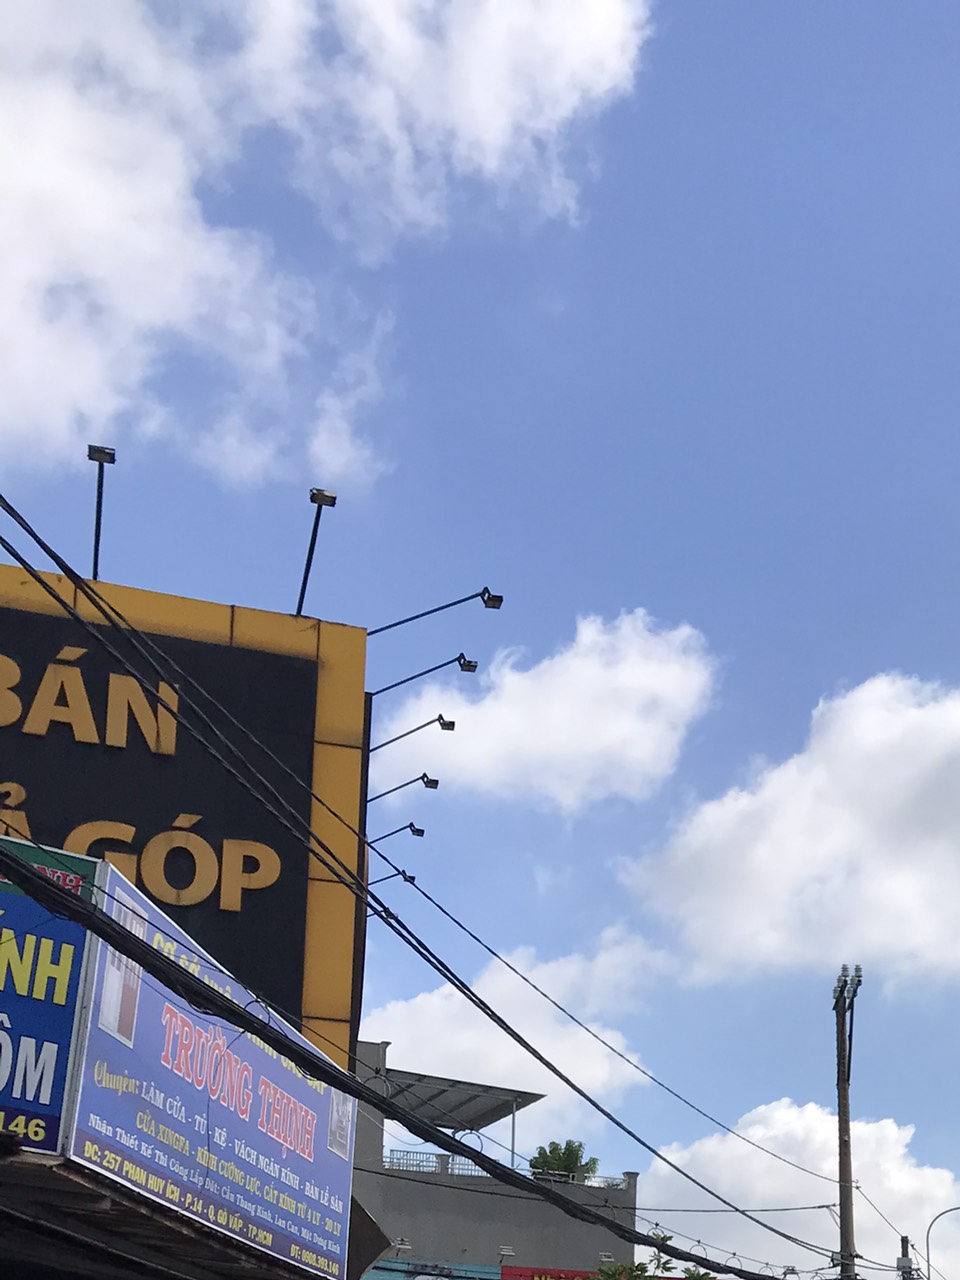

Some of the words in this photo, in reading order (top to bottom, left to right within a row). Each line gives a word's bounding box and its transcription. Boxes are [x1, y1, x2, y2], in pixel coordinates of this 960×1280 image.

[63, 813, 281, 912] GÓP
[0, 910, 75, 1006] NH
[161, 1003, 253, 1122] TRƯỜNG
[258, 1075, 317, 1162] THỊNH
[88, 1113, 113, 1137] Nhận
[115, 1127, 139, 1151] Thiết
[140, 1141, 154, 1159] Kế
[154, 1150, 168, 1167] Thi
[169, 1158, 189, 1181] Công
[136, 1109, 156, 1137] CỬA
[278, 1191, 296, 1214] KÍNH
[141, 1081, 165, 1109] LÀM
[166, 1096, 186, 1123] CỬA
[213, 1127, 227, 1150] KỆ
[234, 1139, 257, 1165] VÁCH
[281, 1166, 300, 1190] KÍNH
[84, 1141, 101, 1163] ĐC:
[102, 1150, 122, 1171] 257
[122, 1160, 147, 1186] PHAN
[147, 1172, 166, 1195] HUY
[165, 1180, 181, 1200] ÍCH
[228, 1212, 243, 1232] VẤP
